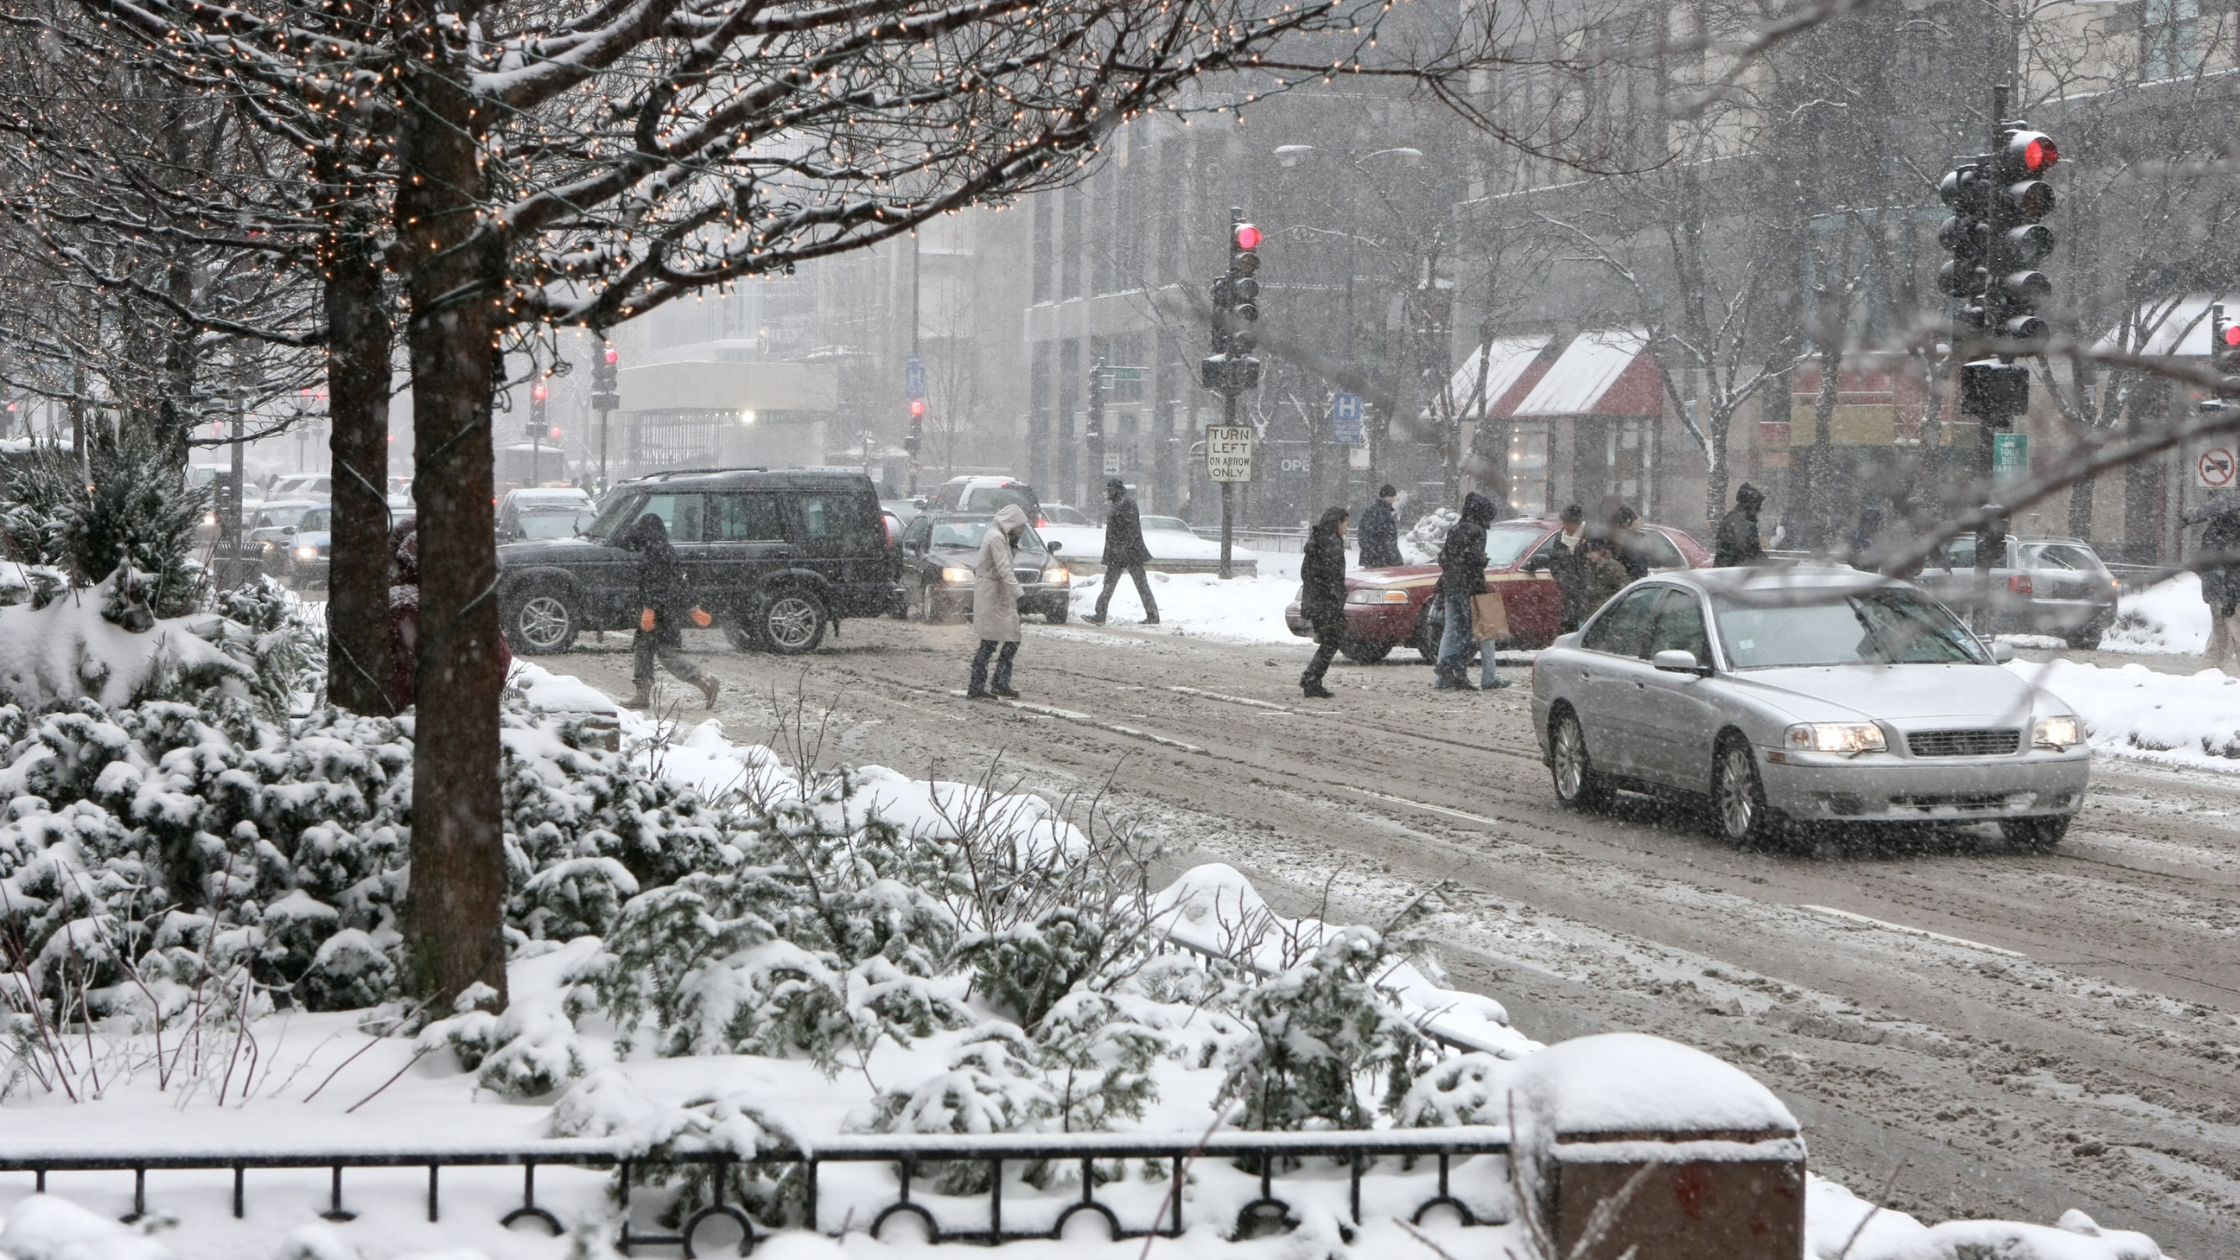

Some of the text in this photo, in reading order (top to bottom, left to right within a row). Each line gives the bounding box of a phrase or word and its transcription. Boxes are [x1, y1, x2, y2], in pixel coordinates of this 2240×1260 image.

[1339, 397, 1356, 418] H
[1210, 429, 1249, 440] TURN
[1213, 443, 1248, 453] LEFT
[2000, 448, 2020, 457] TOUR
[1210, 457, 1250, 466] ON ARROW
[2001, 456, 2018, 465] BUS
[1213, 468, 1245, 477] ONLY
